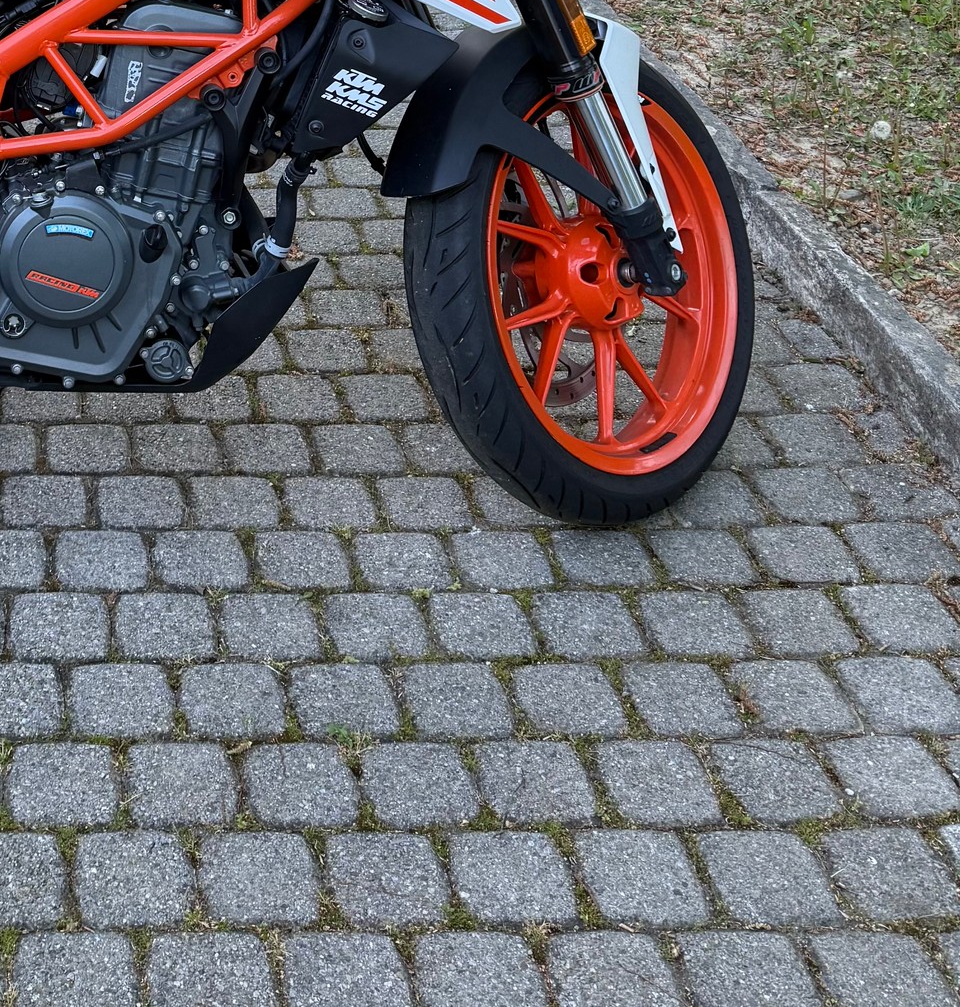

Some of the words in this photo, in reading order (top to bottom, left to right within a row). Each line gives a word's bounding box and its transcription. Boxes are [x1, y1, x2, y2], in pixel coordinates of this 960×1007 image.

[325, 80, 388, 111] KMS
[333, 68, 385, 96] KTM
[320, 92, 378, 118] RACING
